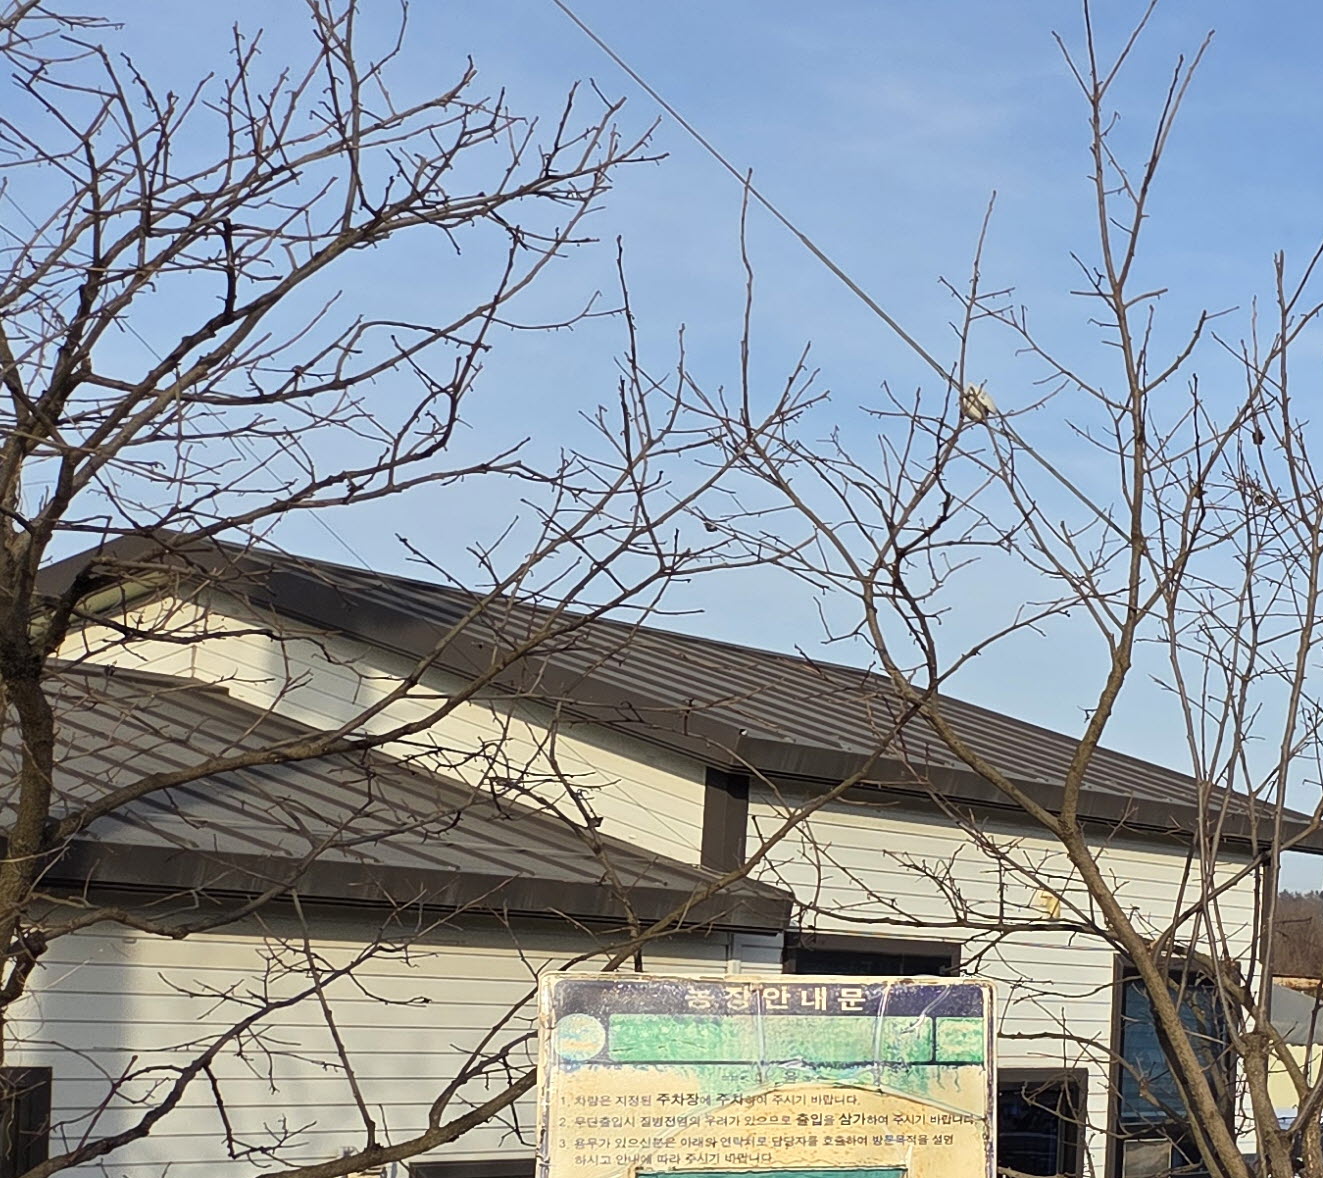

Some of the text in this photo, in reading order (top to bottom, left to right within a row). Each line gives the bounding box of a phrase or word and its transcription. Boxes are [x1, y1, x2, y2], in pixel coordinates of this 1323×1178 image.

[575, 1095, 611, 1106] 차량은
[615, 1095, 652, 1106] 지정된
[657, 1093, 711, 1106] 주차장에
[772, 1094, 807, 1105] 주시기
[575, 1116, 636, 1128] 무단출입시
[640, 1115, 700, 1128] 질병전염의
[706, 1115, 740, 1127] 우려가
[745, 1115, 792, 1126] 있으므로
[797, 1113, 834, 1125] 출입을
[839, 1113, 889, 1126] 삼가하여
[893, 1114, 926, 1125] 주시기
[575, 1138, 611, 1149] 용무가
[615, 1137, 676, 1149] 있으신분은
[680, 1137, 717, 1148] 아래와
[772, 1136, 818, 1148] 담당자를
[823, 1135, 868, 1146] 호출하여
[932, 1134, 954, 1145] 설명
[575, 1154, 612, 1165] 하시고
[657, 1153, 680, 1164] 따라
[685, 1153, 720, 1164] 주시기
